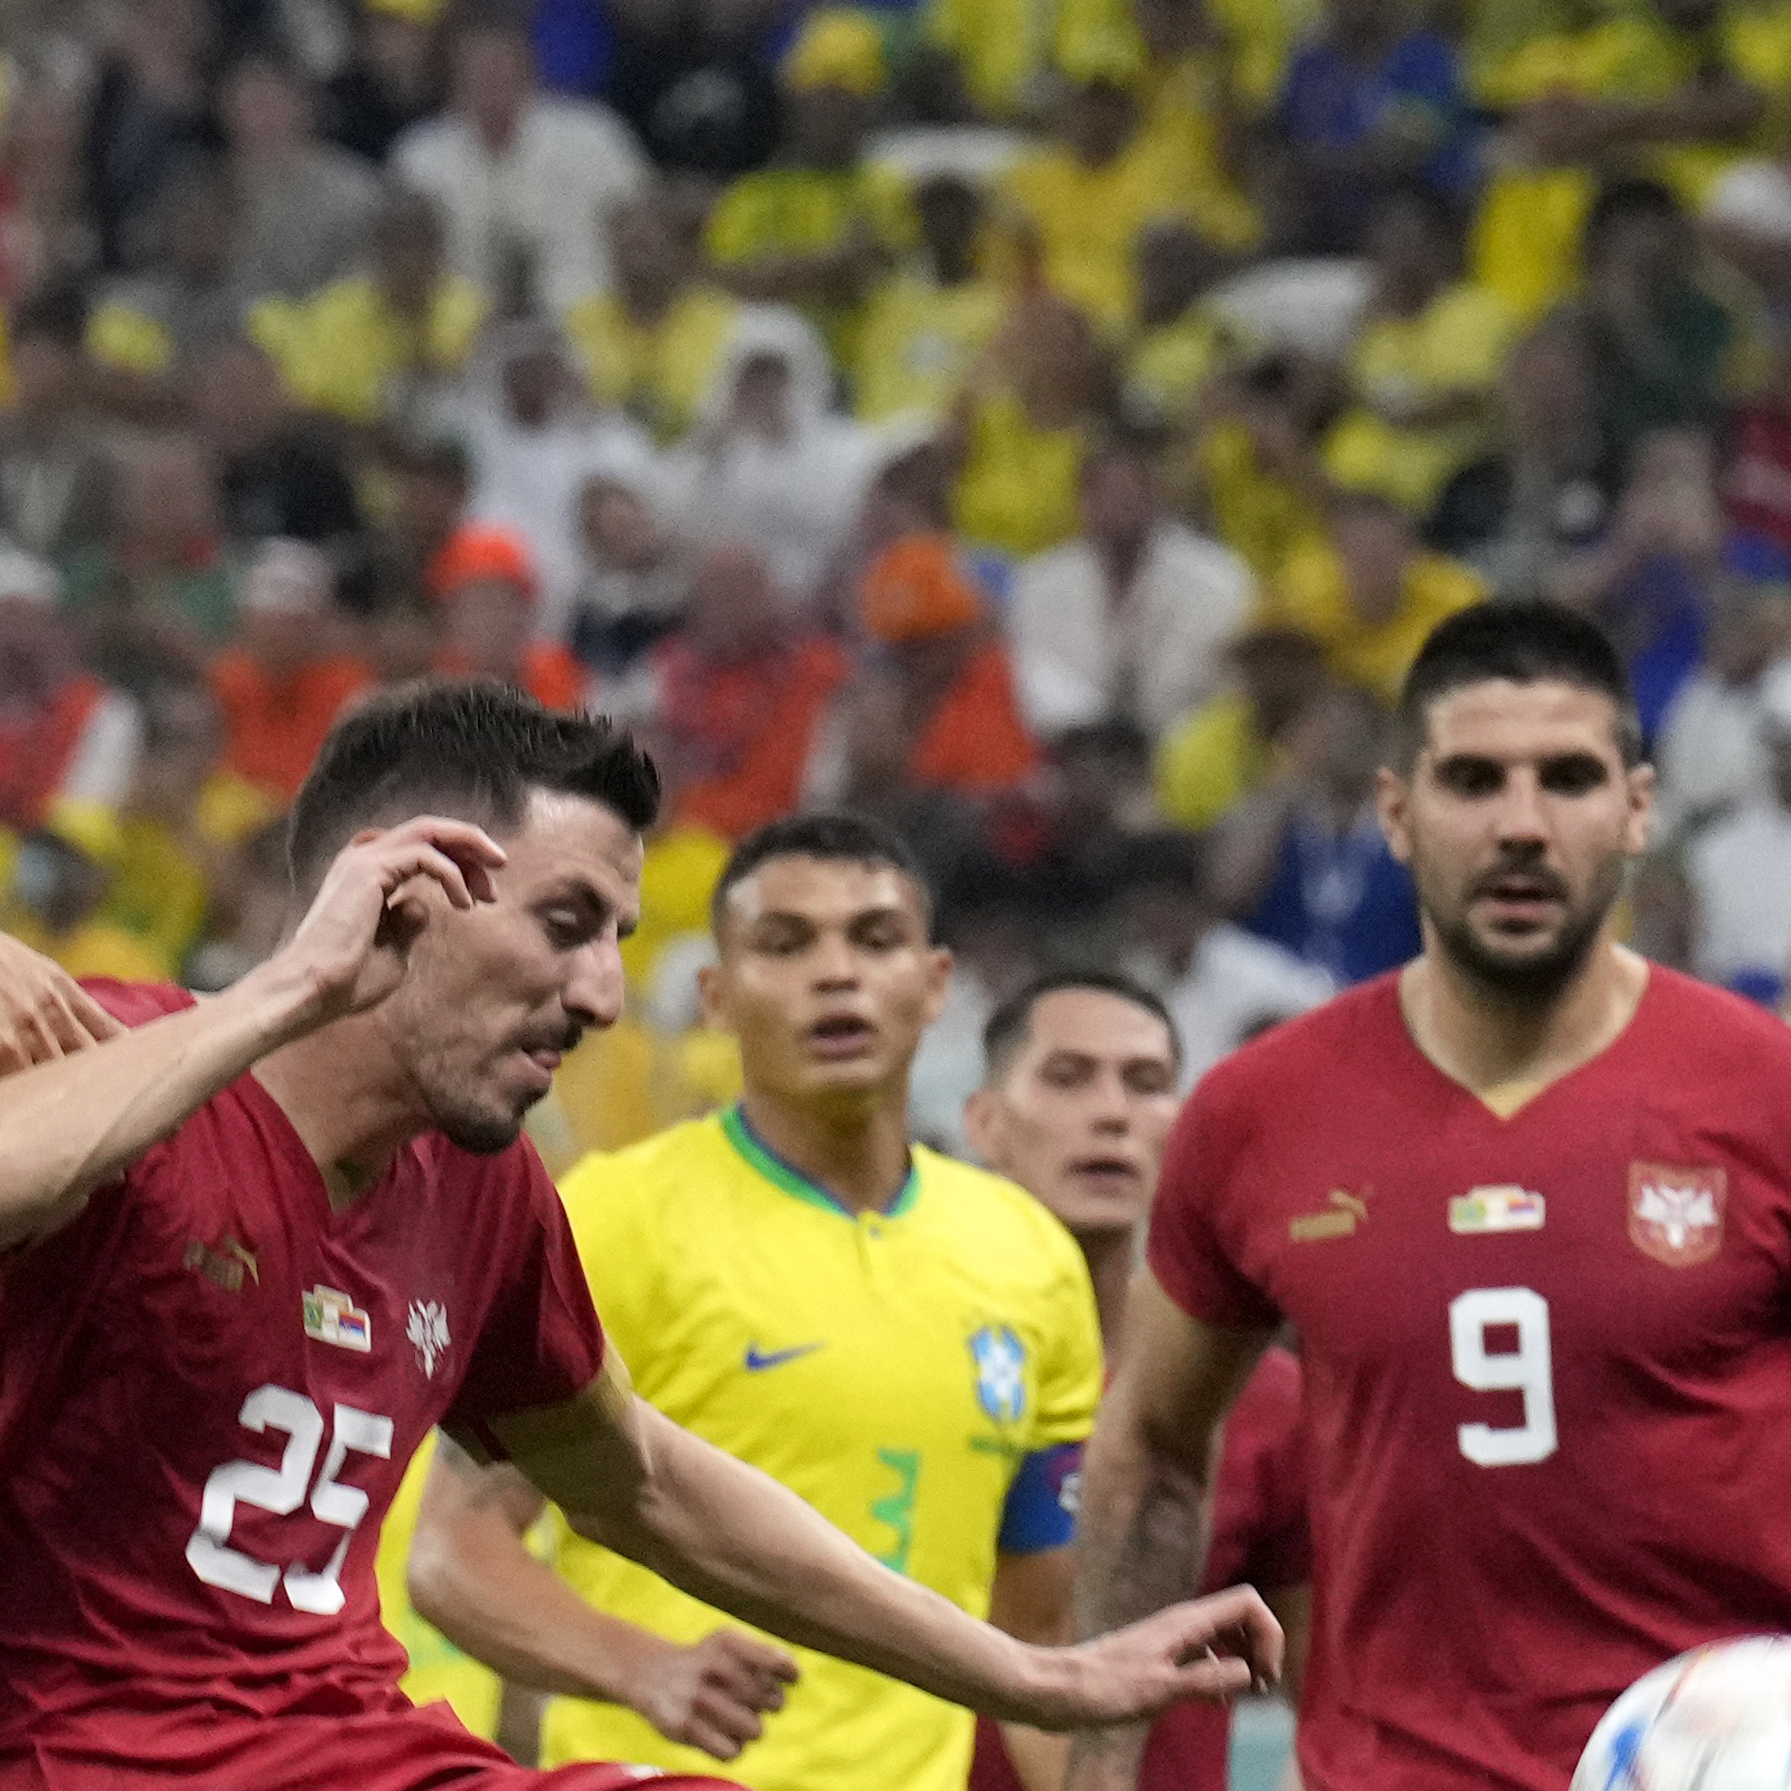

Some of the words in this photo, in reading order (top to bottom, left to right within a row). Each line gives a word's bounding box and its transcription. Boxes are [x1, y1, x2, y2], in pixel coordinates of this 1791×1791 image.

[1449, 1286, 1558, 1467] 9
[185, 1384, 395, 1616] 25
[869, 1448, 924, 1574] 3
